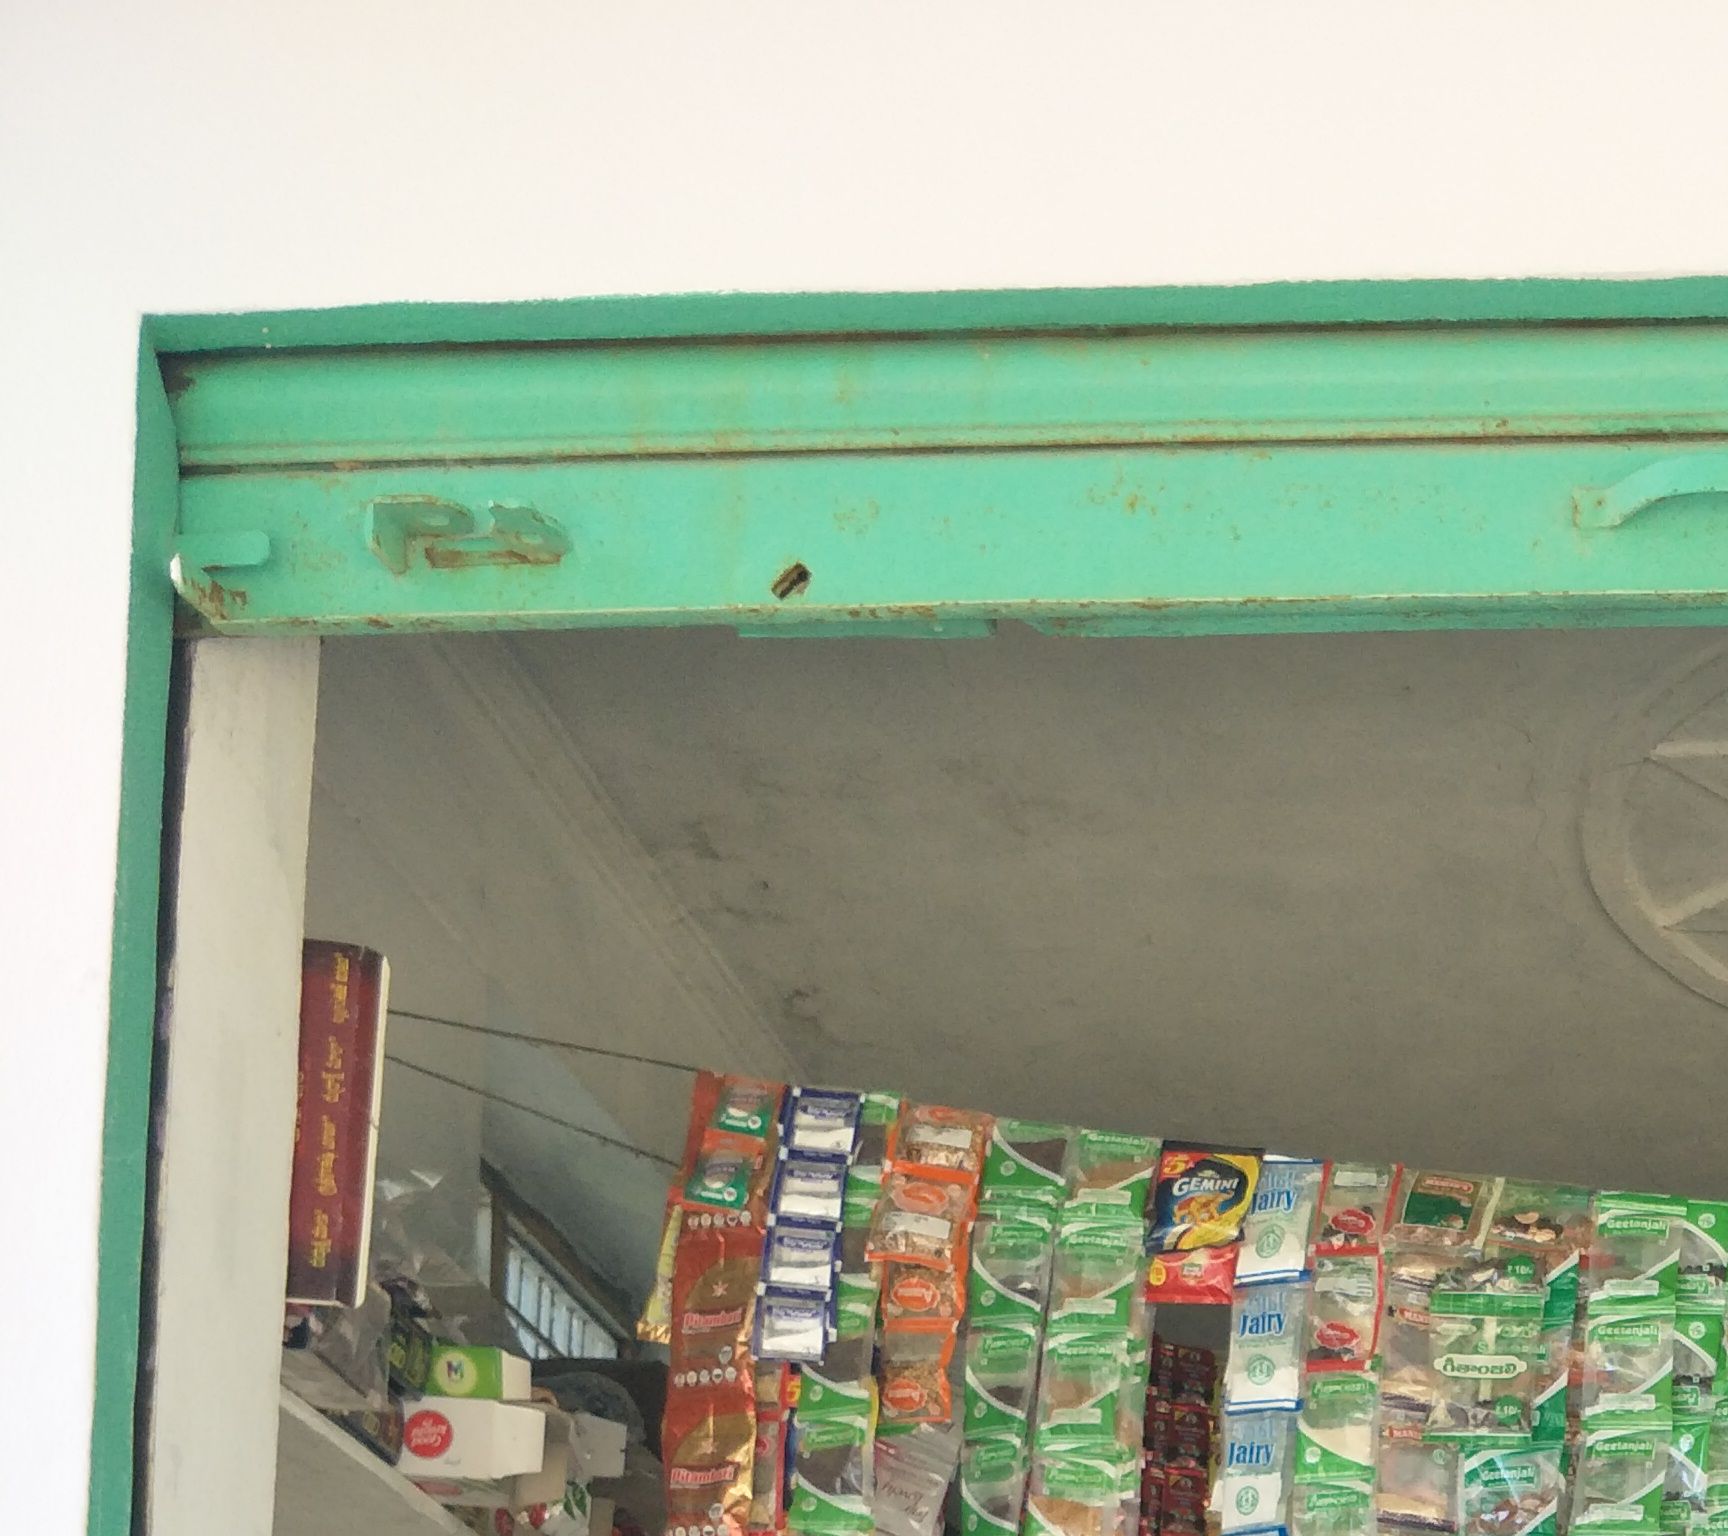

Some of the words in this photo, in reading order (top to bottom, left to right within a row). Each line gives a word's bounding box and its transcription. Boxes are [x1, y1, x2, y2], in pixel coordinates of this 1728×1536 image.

[1172, 1175, 1239, 1196] GEMINI
[1606, 1217, 1665, 1229] Geetanjali
[1598, 1324, 1659, 1336] Geetanjali
[1596, 1440, 1653, 1452] Geetanjali
